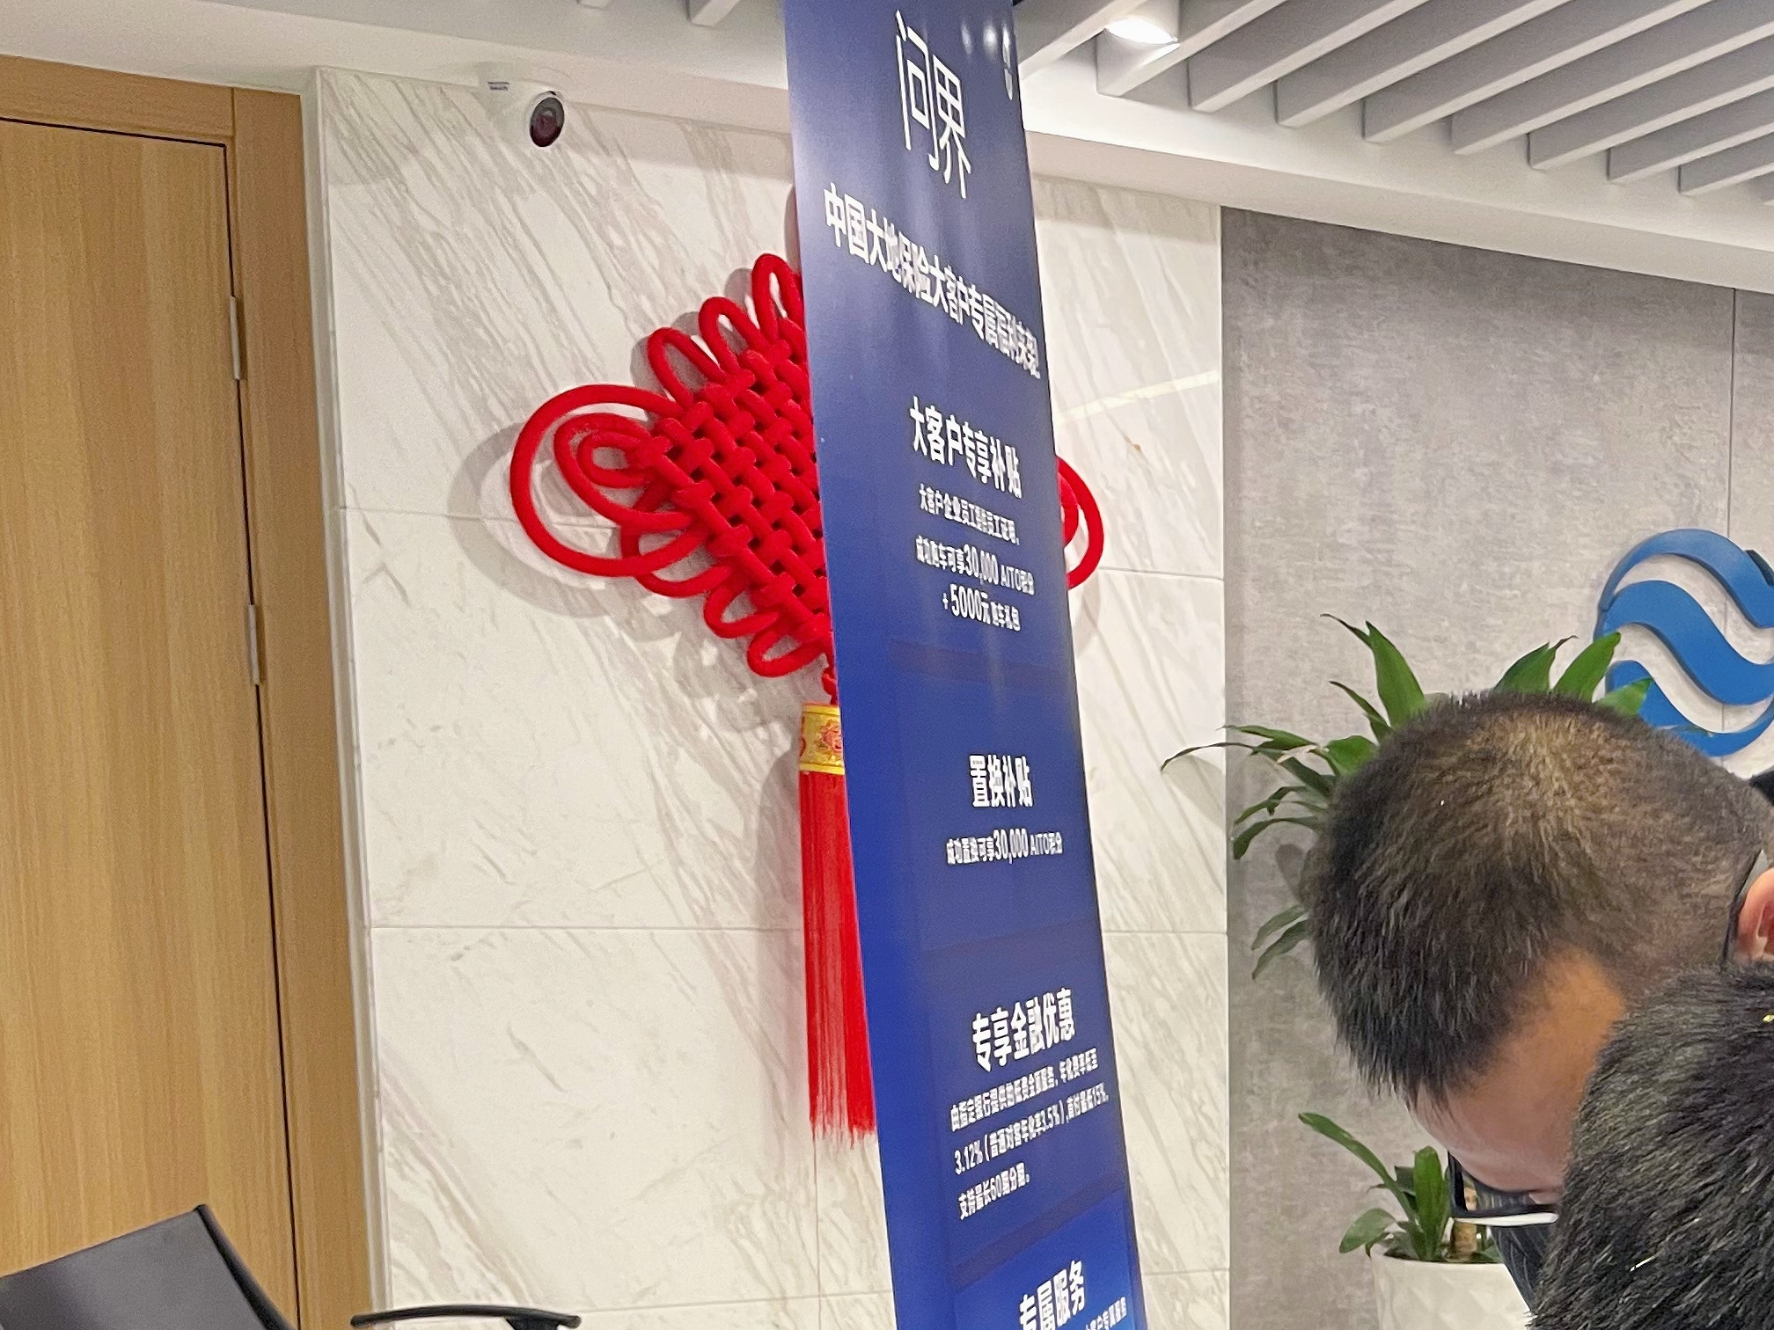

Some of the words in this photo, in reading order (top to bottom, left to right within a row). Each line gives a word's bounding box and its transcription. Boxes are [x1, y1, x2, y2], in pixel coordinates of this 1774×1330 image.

[895, 10, 972, 199] 问界
[909, 396, 1022, 498] 大客户专享补贴
[969, 754, 1034, 807] 置换补贴
[972, 987, 1075, 1072] 专享金融优惠
